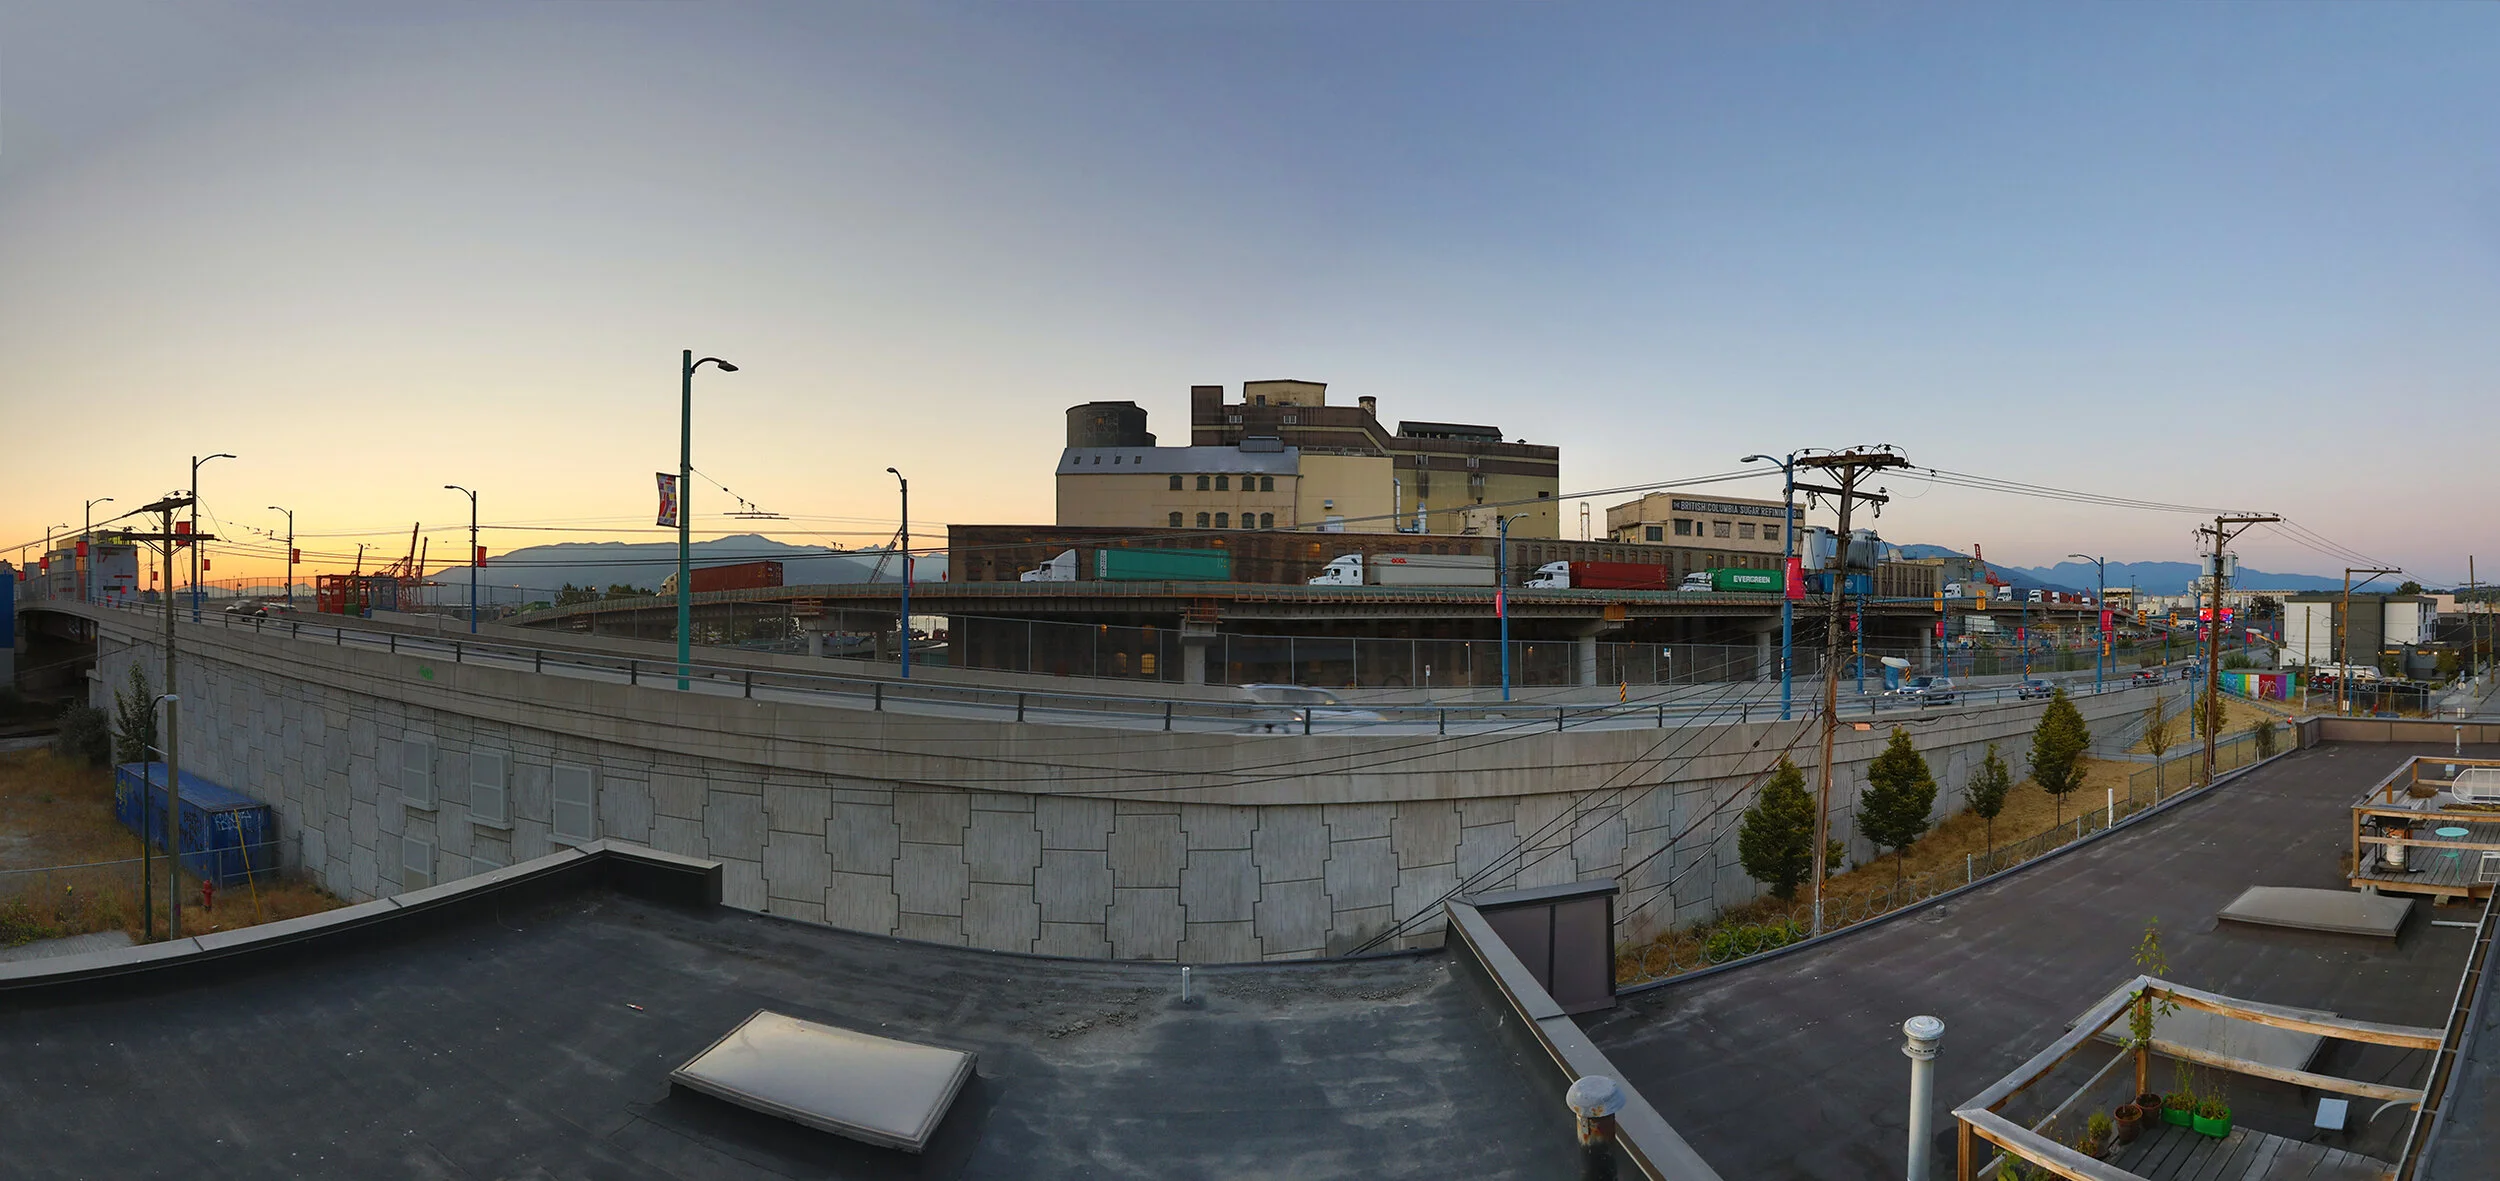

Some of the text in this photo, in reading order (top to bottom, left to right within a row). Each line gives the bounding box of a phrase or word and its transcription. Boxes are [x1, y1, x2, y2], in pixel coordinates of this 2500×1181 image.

[1681, 501, 1706, 511] BRITISH
[1707, 503, 1739, 513] COLUMBIA
[1740, 505, 1760, 515] SUGAR
[1733, 575, 1771, 583] EVERGREEN
